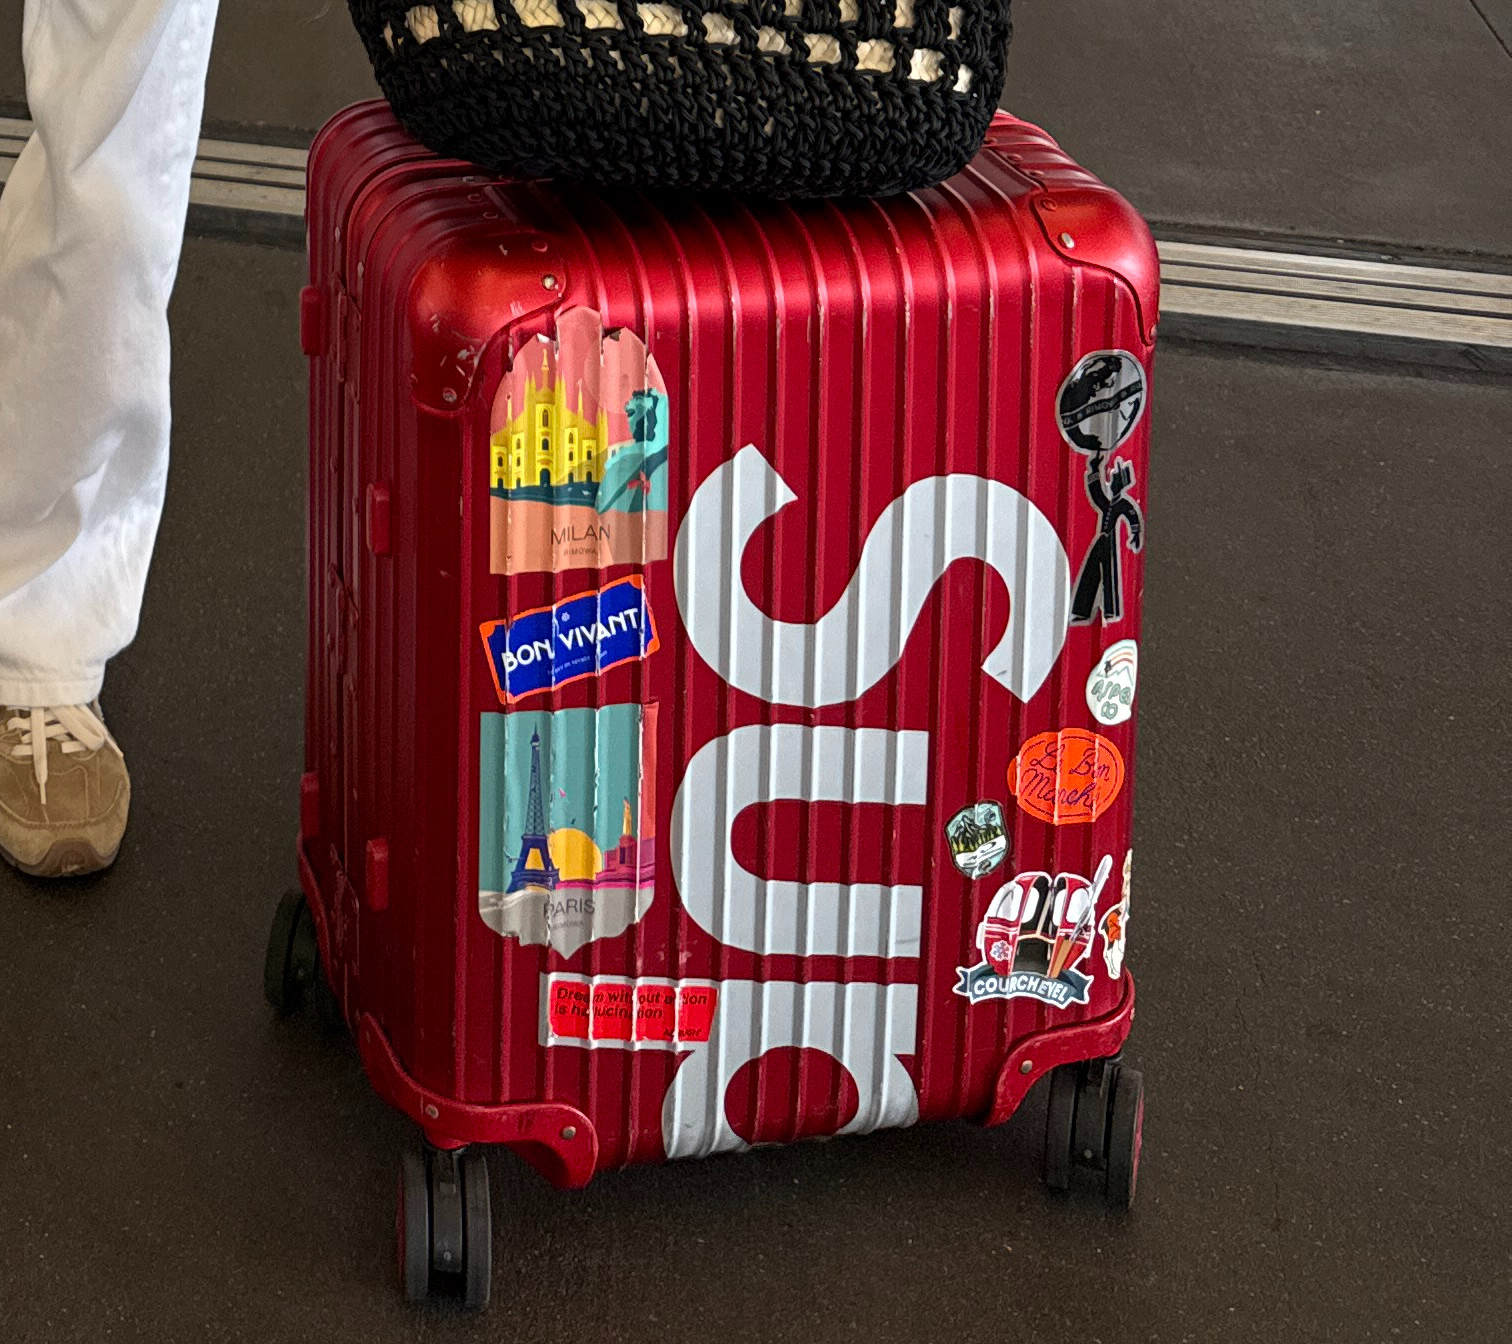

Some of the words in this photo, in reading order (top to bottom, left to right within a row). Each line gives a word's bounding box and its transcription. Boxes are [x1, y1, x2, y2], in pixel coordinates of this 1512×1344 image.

[551, 524, 611, 545] MILAN
[501, 639, 555, 672] BON
[558, 608, 638, 650] VIVANT
[543, 898, 596, 919] PARIS
[608, 989, 660, 1005] witout
[973, 974, 1070, 1003] COURCHEVEL
